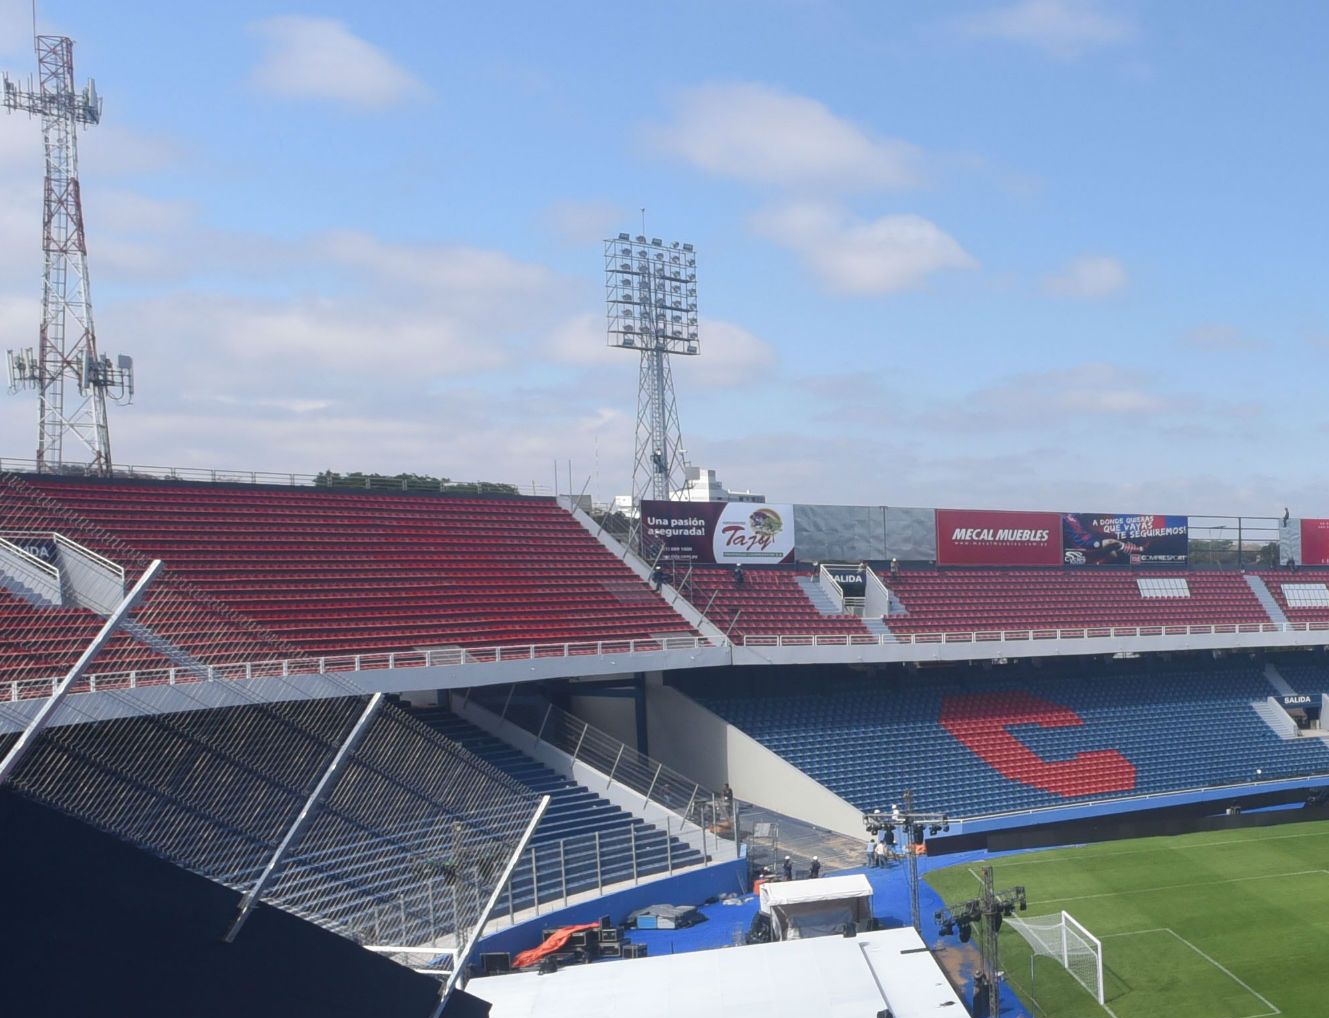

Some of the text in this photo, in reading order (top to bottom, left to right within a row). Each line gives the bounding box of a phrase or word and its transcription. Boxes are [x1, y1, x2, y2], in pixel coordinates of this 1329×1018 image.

[647, 517, 705, 527] Una pasión
[1100, 518, 1124, 526] DONDE
[1103, 521, 1153, 533] QUE VAYAS
[648, 527, 705, 537] asegurada!
[952, 528, 1049, 541] MECAL MUEBLES
[1115, 526, 1187, 540] TE SEGUIREMOS!
[722, 526, 772, 551] Tajy
[833, 574, 863, 583] ALIDA
[1284, 696, 1311, 704] SALIDA
